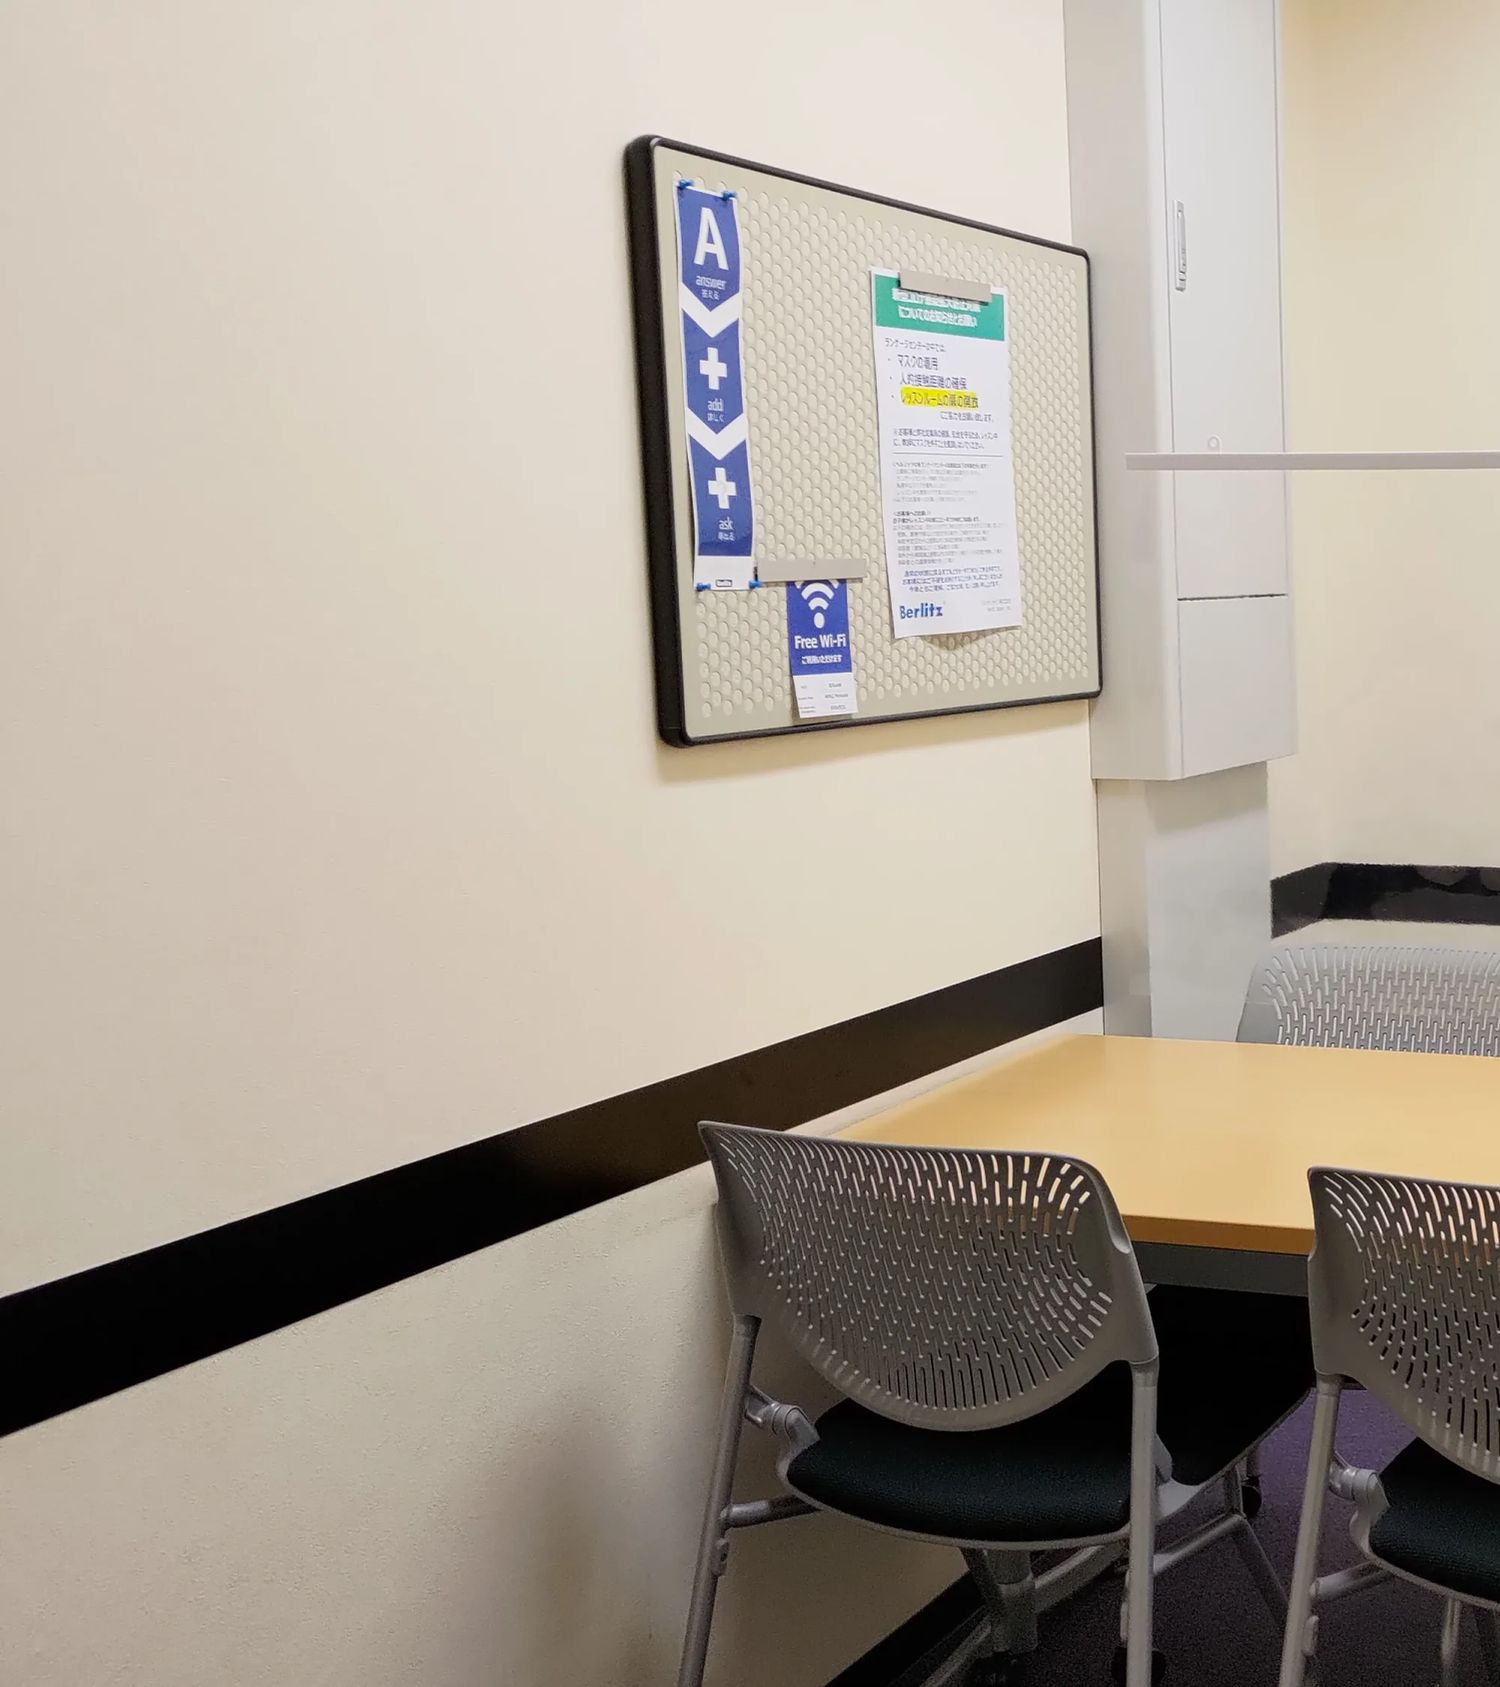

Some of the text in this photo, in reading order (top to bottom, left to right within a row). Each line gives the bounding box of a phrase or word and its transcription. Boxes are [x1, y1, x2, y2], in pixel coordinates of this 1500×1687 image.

[693, 207, 729, 270] A
[695, 275, 727, 290] answer
[707, 397, 724, 411] add
[719, 516, 734, 530] ask
[900, 602, 943, 619] Berlitz
[794, 633, 846, 649] Free Wi-Fi
